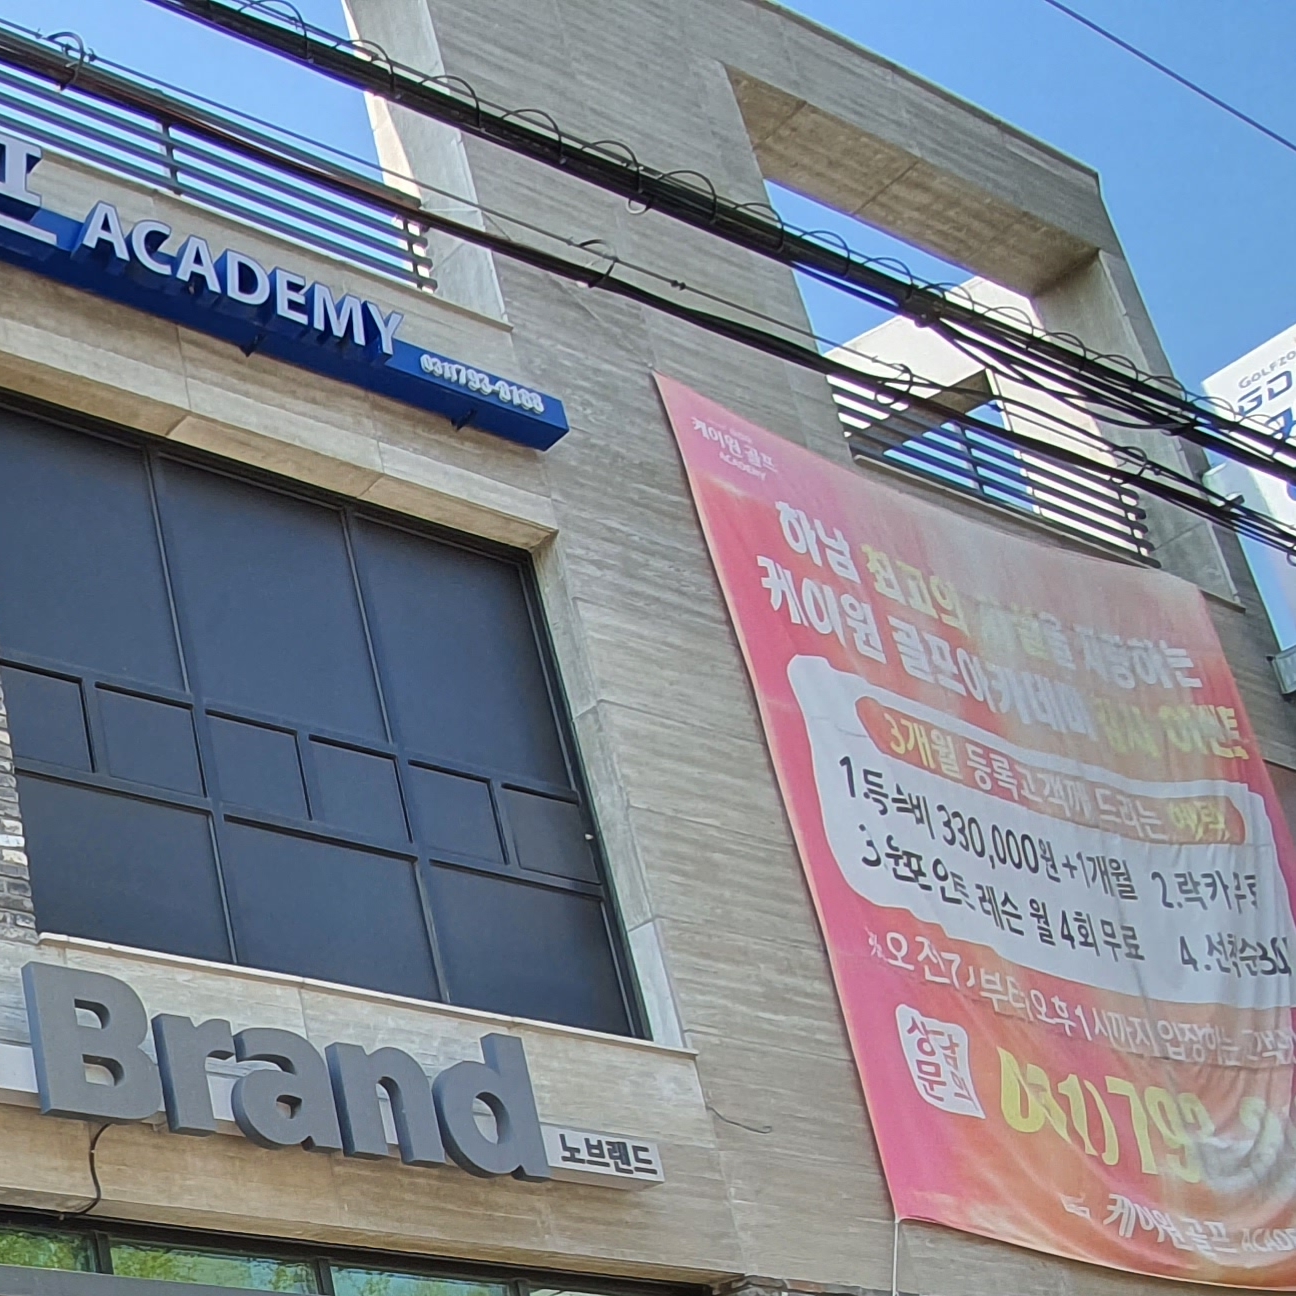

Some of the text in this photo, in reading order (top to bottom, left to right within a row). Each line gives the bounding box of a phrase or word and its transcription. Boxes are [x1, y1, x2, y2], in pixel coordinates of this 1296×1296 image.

[84, 200, 404, 356] ACADEMY
[757, 555, 886, 665] 케이원
[775, 501, 861, 584] 하남
[861, 544, 969, 637] 최고의
[884, 713, 964, 780] 3개월
[1029, 898, 1056, 946] 월
[21, 961, 552, 1183] Brand
[559, 1133, 659, 1175] 노브랜드
